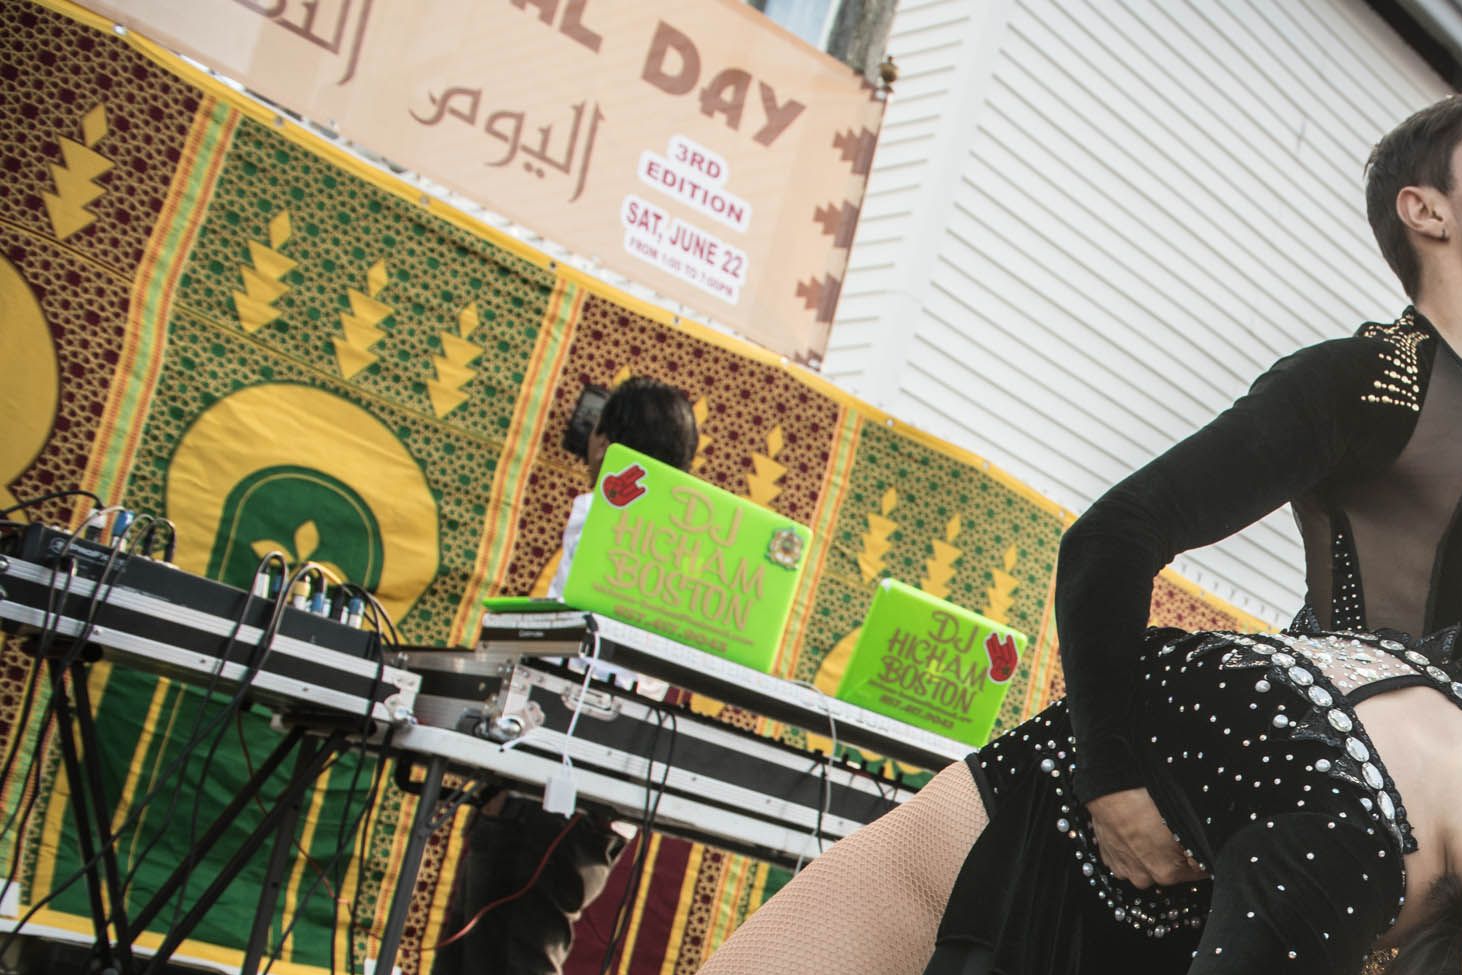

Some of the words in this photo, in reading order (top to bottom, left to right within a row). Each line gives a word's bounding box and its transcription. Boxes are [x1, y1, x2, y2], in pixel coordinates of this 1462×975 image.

[641, 19, 806, 147] DAY
[409, 86, 604, 203] اليوم
[675, 143, 721, 179] 3RD
[646, 159, 744, 223] EDITION
[626, 202, 663, 244] SAT,
[669, 226, 719, 266] JUNE
[721, 250, 744, 279] 22
[629, 236, 659, 260] FROM
[669, 485, 744, 547] DJ
[612, 509, 767, 600] HICHAM
[604, 548, 755, 632] BOSTON
[886, 626, 990, 693] HICHAM
[928, 609, 980, 654] DJ
[877, 655, 978, 715] BOSTON
